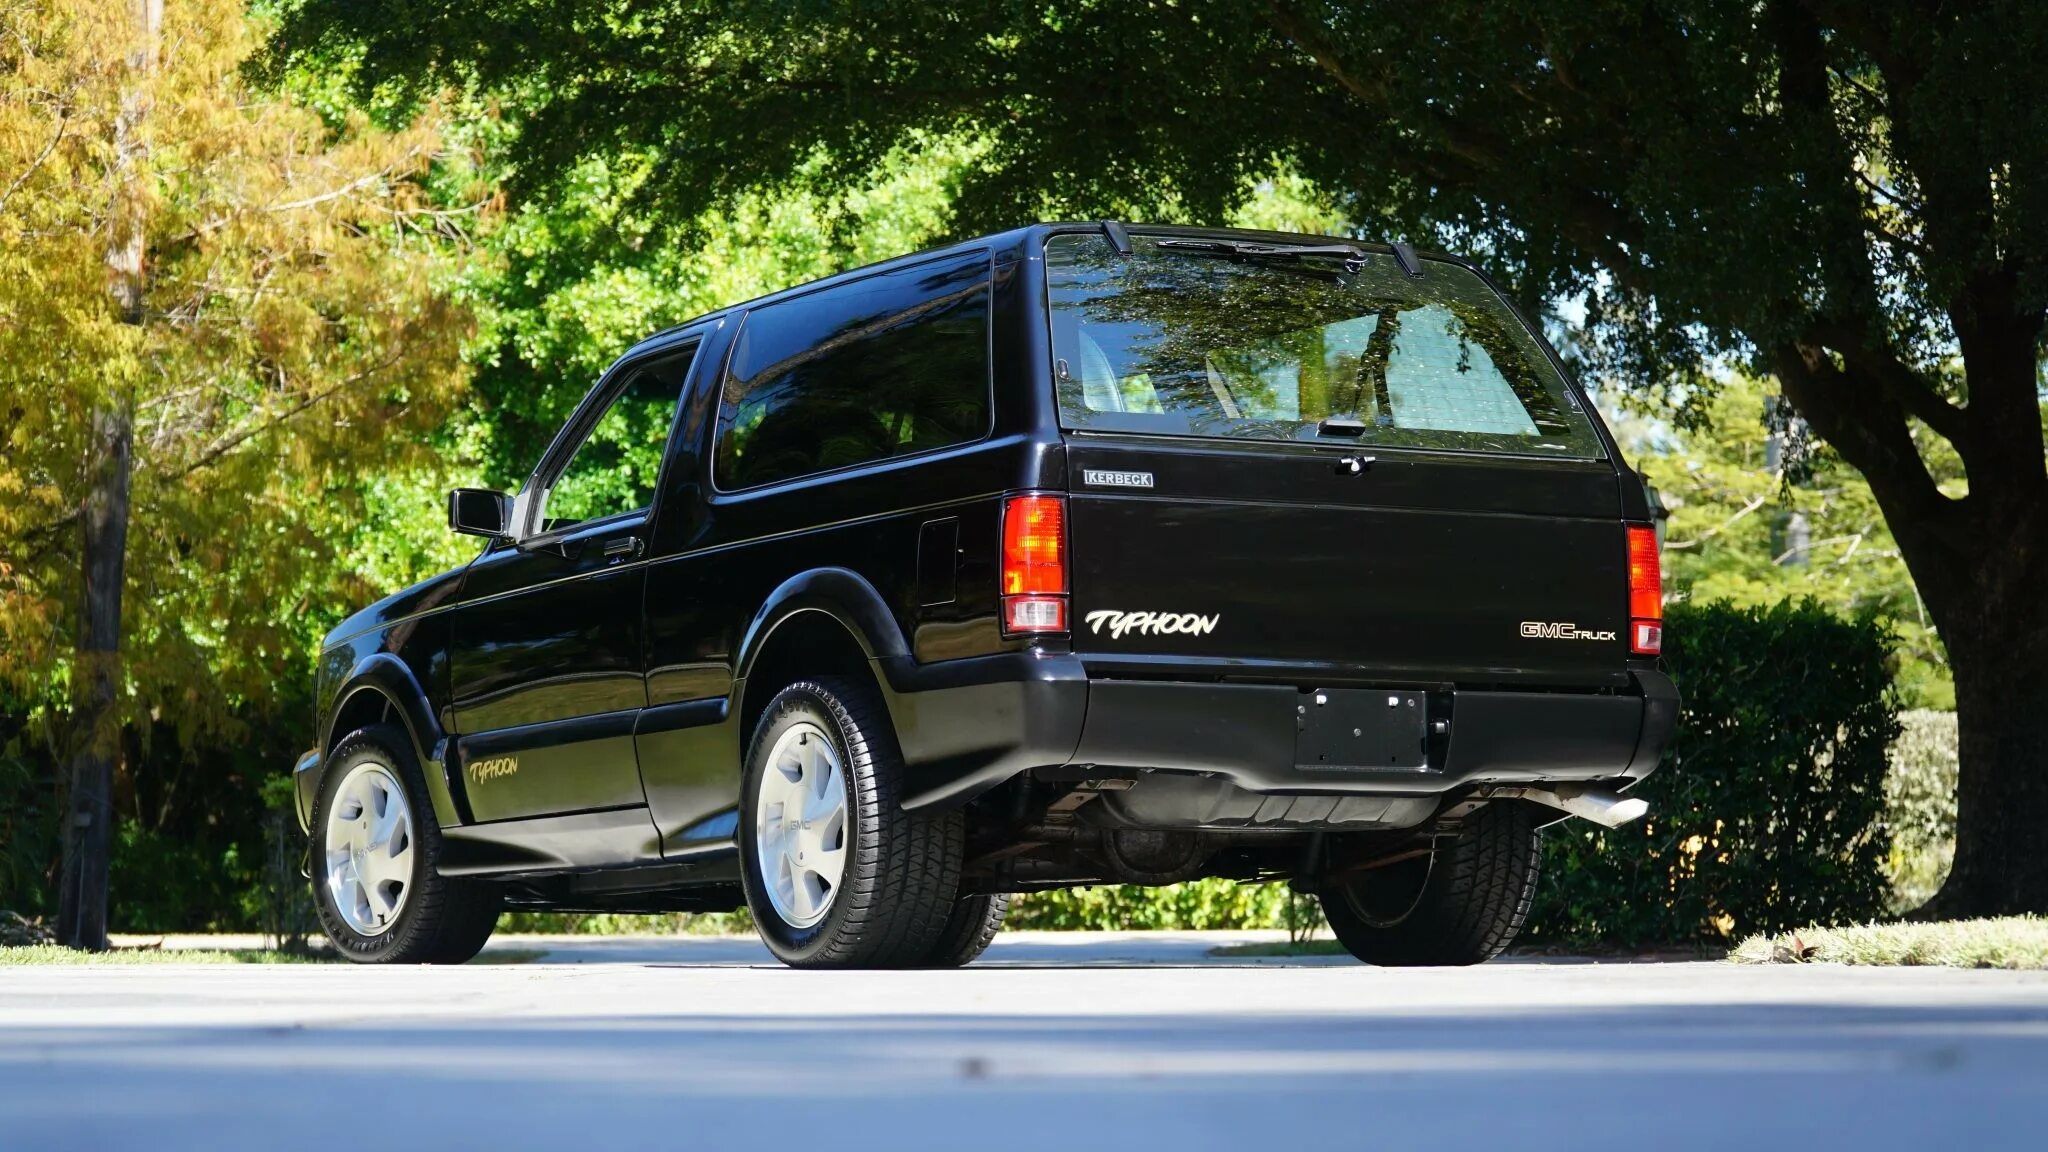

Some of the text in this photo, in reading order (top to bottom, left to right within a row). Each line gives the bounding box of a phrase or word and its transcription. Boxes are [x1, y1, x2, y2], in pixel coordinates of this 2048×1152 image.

[1087, 472, 1150, 486] KERBECK
[1086, 610, 1220, 640] TYPHOON
[1520, 621, 1616, 641] GMC TRUCK
[469, 756, 519, 785] TYPHOON
[790, 819, 812, 831] GMC
